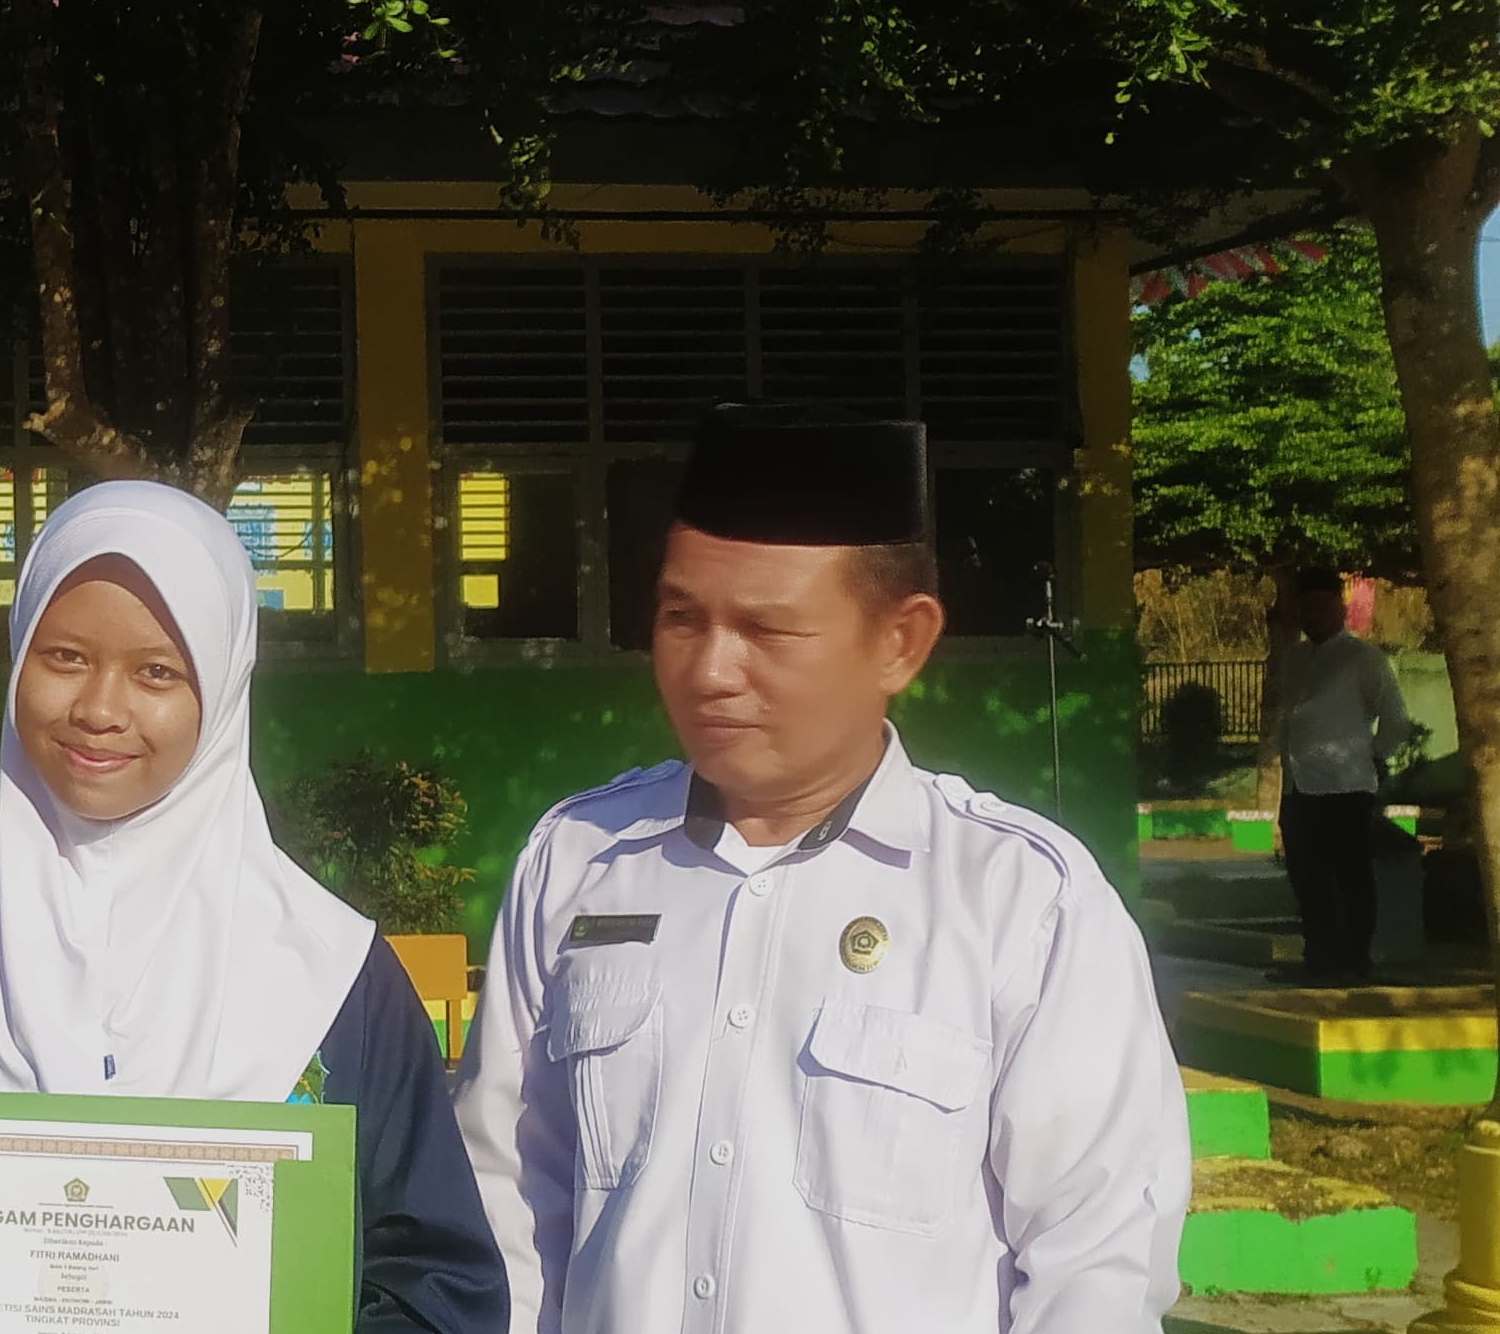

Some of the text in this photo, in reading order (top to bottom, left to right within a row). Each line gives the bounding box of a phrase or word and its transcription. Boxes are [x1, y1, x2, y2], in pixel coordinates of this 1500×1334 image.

[42, 1213, 196, 1233] PENGHARGAAN
[30, 1250, 120, 1262] FITRI RAMADHANI
[25, 1304, 55, 1315] SAINS
[57, 1306, 117, 1317] MADRASAH
[119, 1308, 154, 1319] TAHUN
[156, 1310, 180, 1320] 2024
[25, 1314, 121, 1327] TINGKAT PROVINSI
